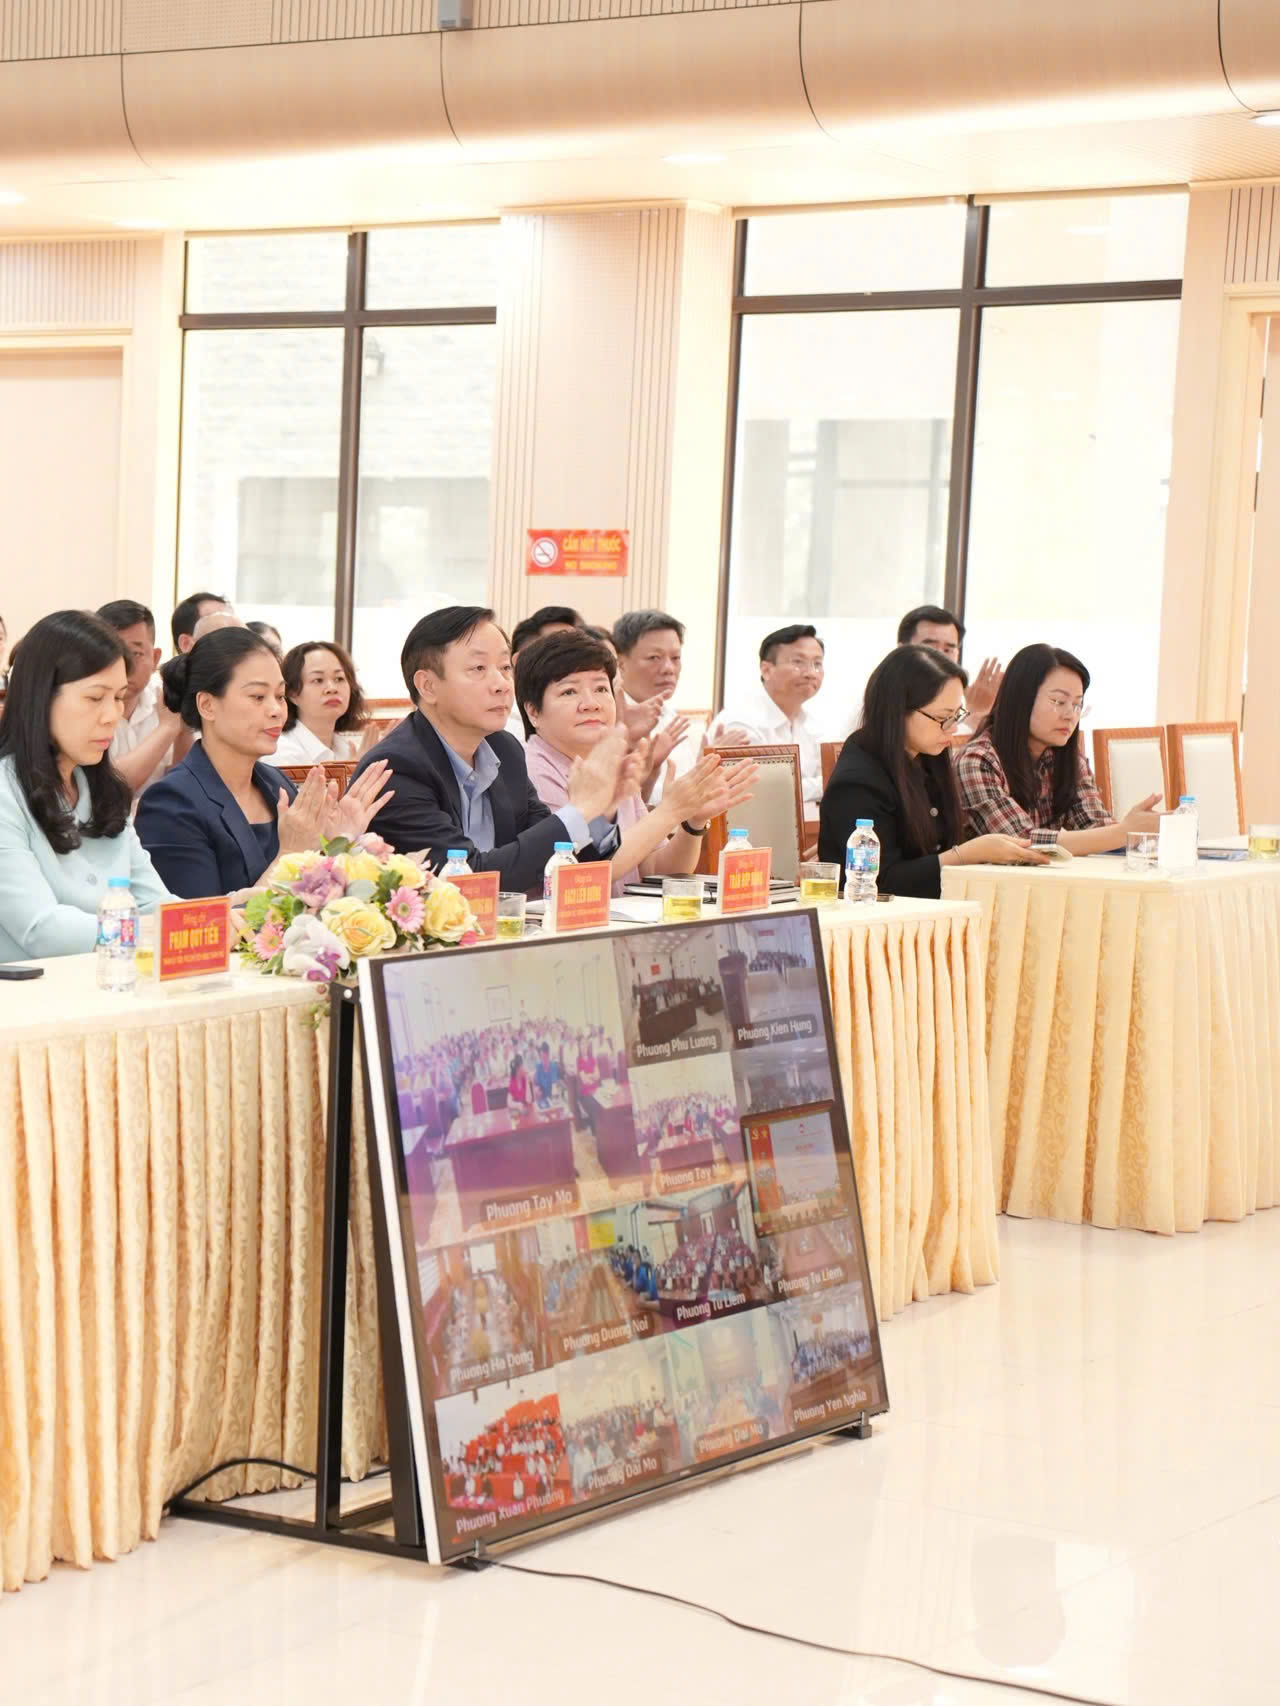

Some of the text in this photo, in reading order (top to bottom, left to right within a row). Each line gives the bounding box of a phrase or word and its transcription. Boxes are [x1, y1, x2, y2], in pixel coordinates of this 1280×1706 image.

[737, 1026, 770, 1041] Phuong
[636, 1042, 671, 1058] Phuong
[486, 1189, 573, 1221] Phuong Tay Mo
[676, 1301, 711, 1321] Phuong
[563, 1332, 600, 1353] Phuong
[632, 1314, 649, 1333] Noi
[793, 1403, 826, 1424] Phuong
[456, 1511, 497, 1535] Phuong
